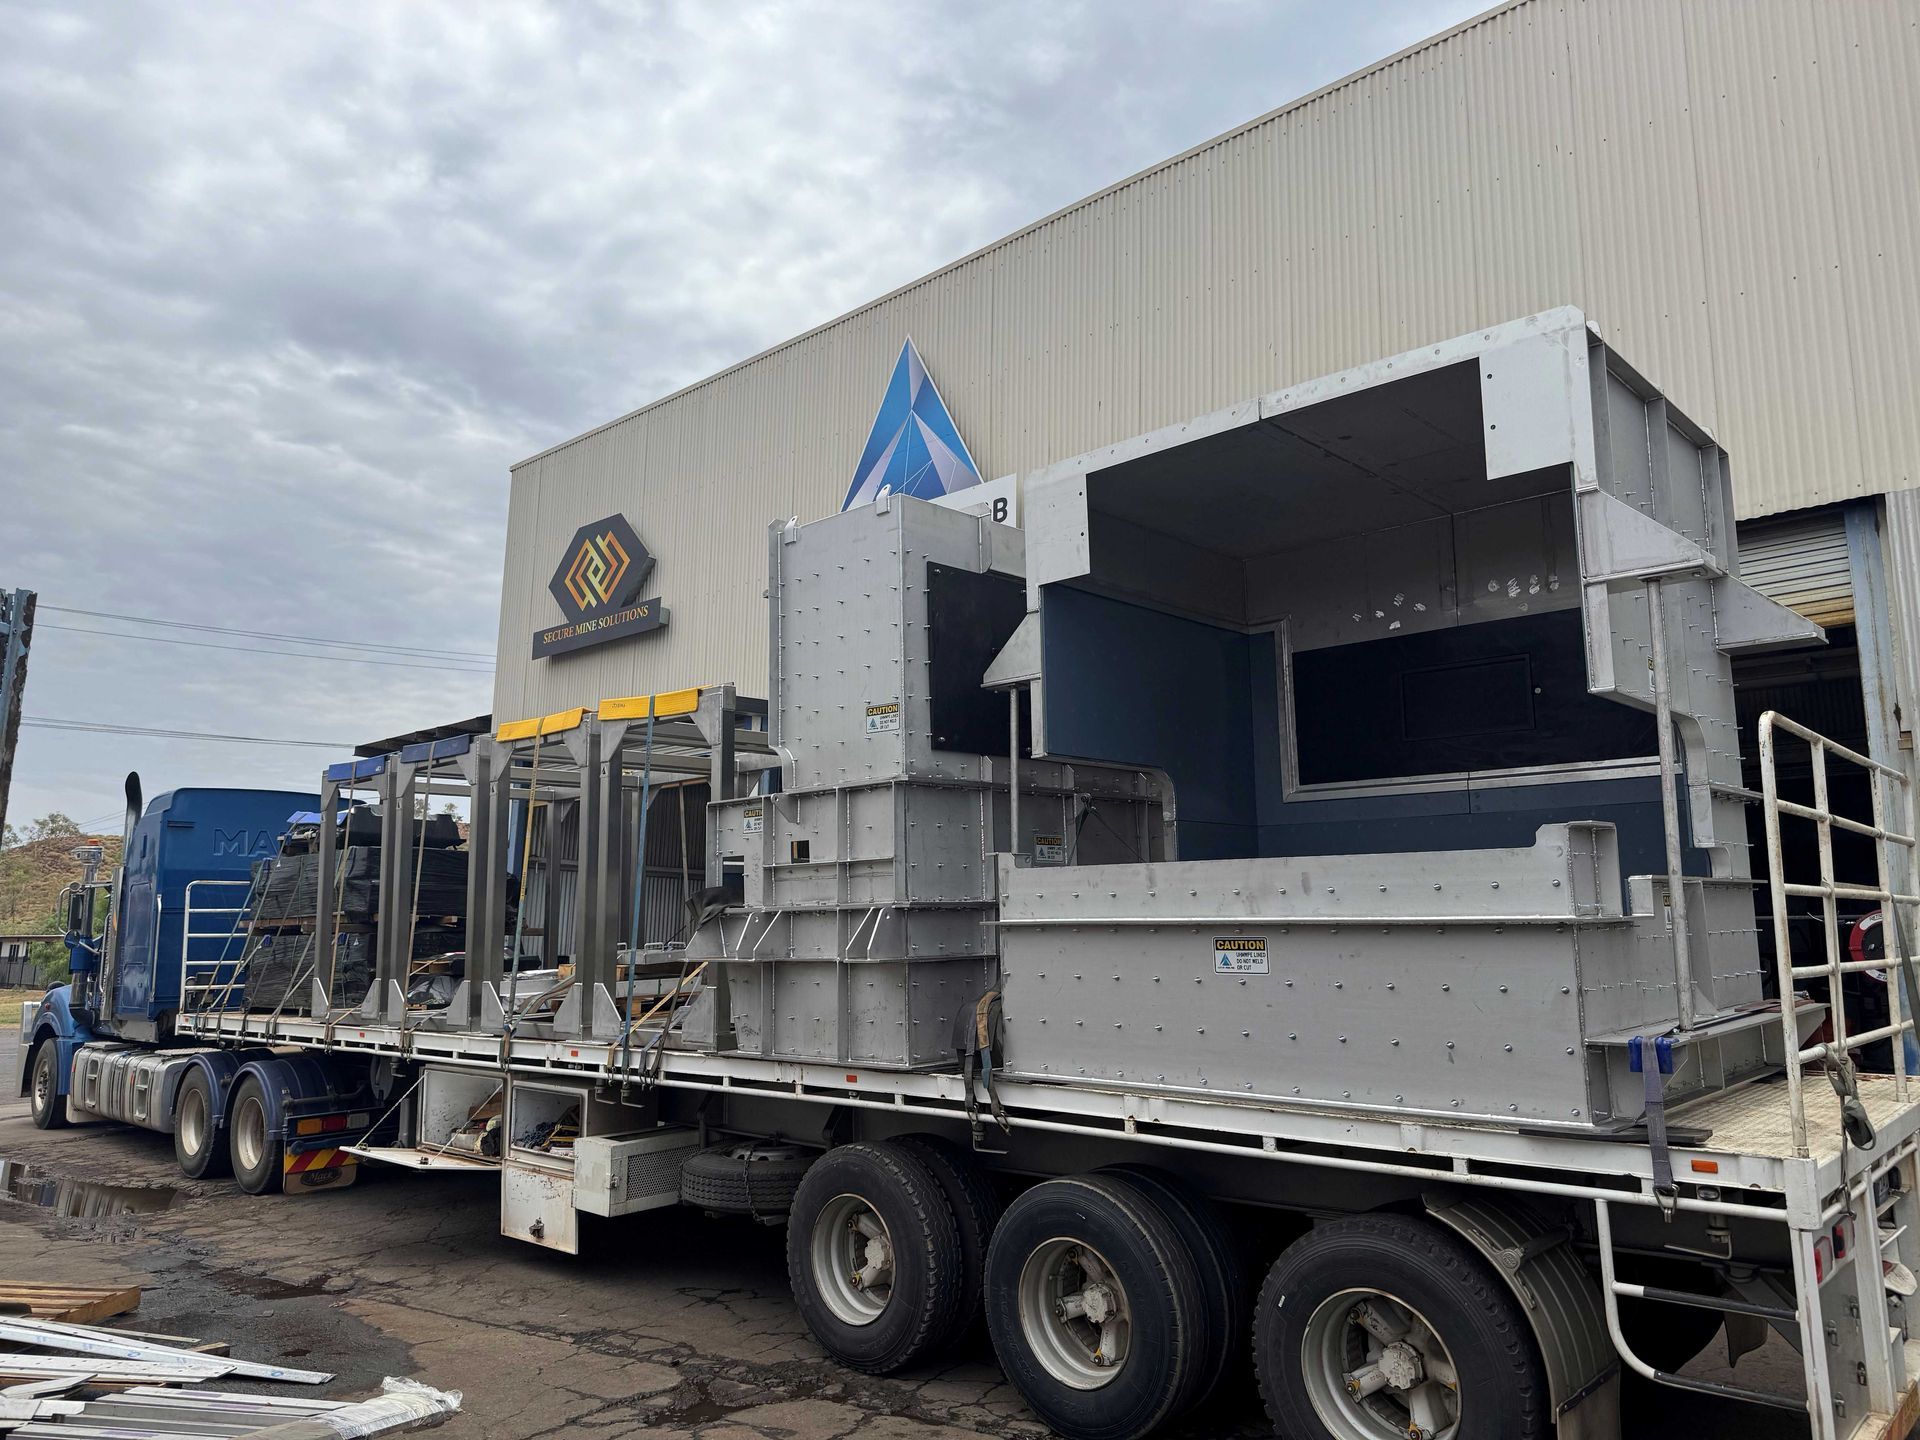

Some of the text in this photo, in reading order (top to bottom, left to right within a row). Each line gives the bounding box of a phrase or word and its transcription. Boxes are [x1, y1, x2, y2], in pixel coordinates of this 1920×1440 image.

[543, 605, 649, 644] SECURE MINE SOLUTIONS
[868, 704, 898, 716] CAUTION
[213, 828, 281, 858] MA
[1037, 837, 1061, 845] CAUTION
[1216, 940, 1264, 950] CAUTION
